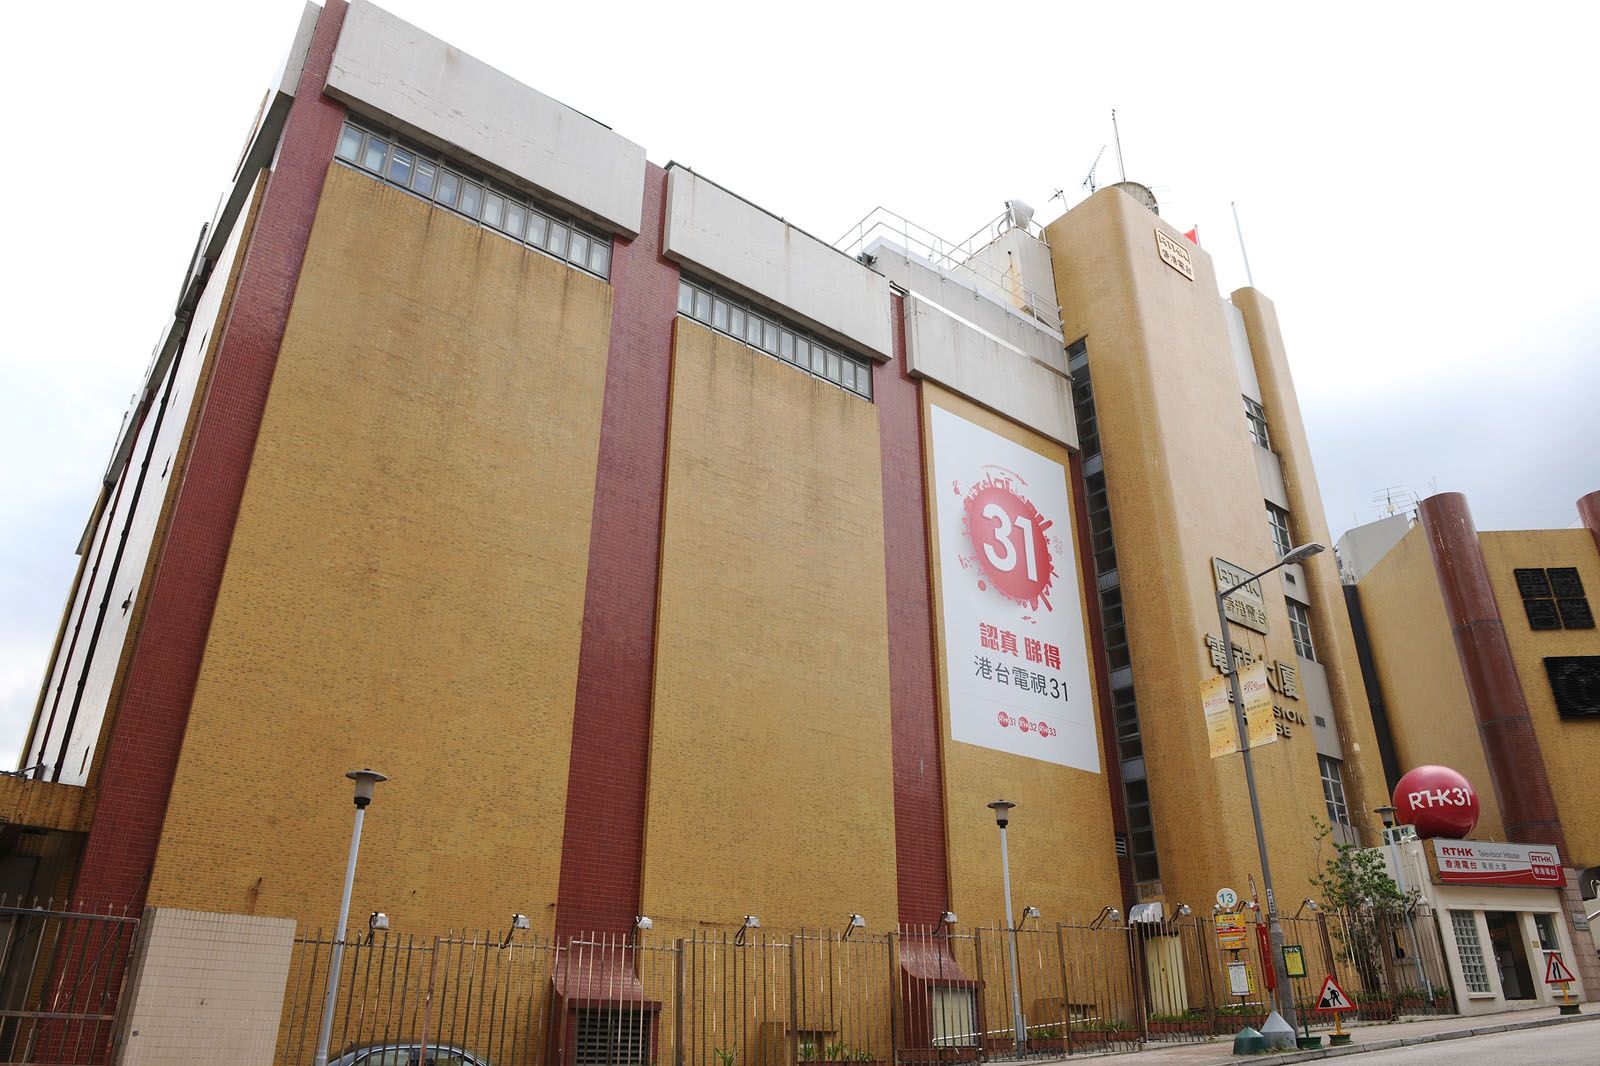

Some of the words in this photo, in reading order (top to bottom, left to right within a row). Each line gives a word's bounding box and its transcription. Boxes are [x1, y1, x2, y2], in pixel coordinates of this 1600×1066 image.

[982, 503, 1038, 582] 31
[979, 622, 1019, 657] 認真
[1023, 636, 1062, 671] 睇得
[1442, 847, 1474, 857] RTHK
[1478, 849, 1502, 858] Television
[1503, 850, 1520, 859] House
[1531, 855, 1552, 863] RTHK
[1445, 860, 1477, 870] 香港電台
[1219, 893, 1234, 904] 13
